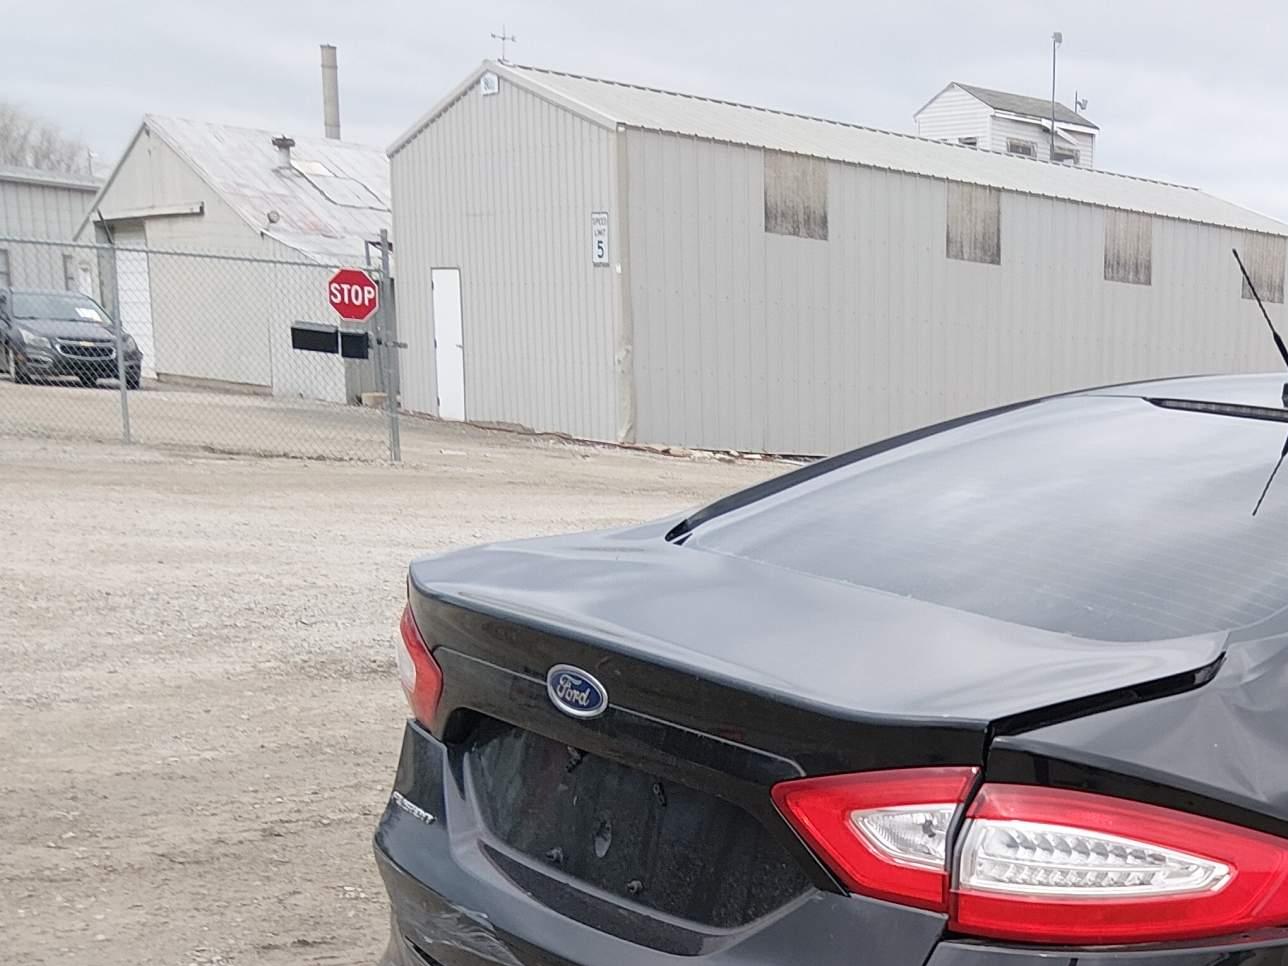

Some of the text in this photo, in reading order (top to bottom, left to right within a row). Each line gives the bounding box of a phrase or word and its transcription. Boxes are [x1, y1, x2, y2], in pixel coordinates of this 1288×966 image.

[597, 240, 604, 259] 5
[330, 282, 375, 306] STOP
[556, 674, 592, 706] Ford
